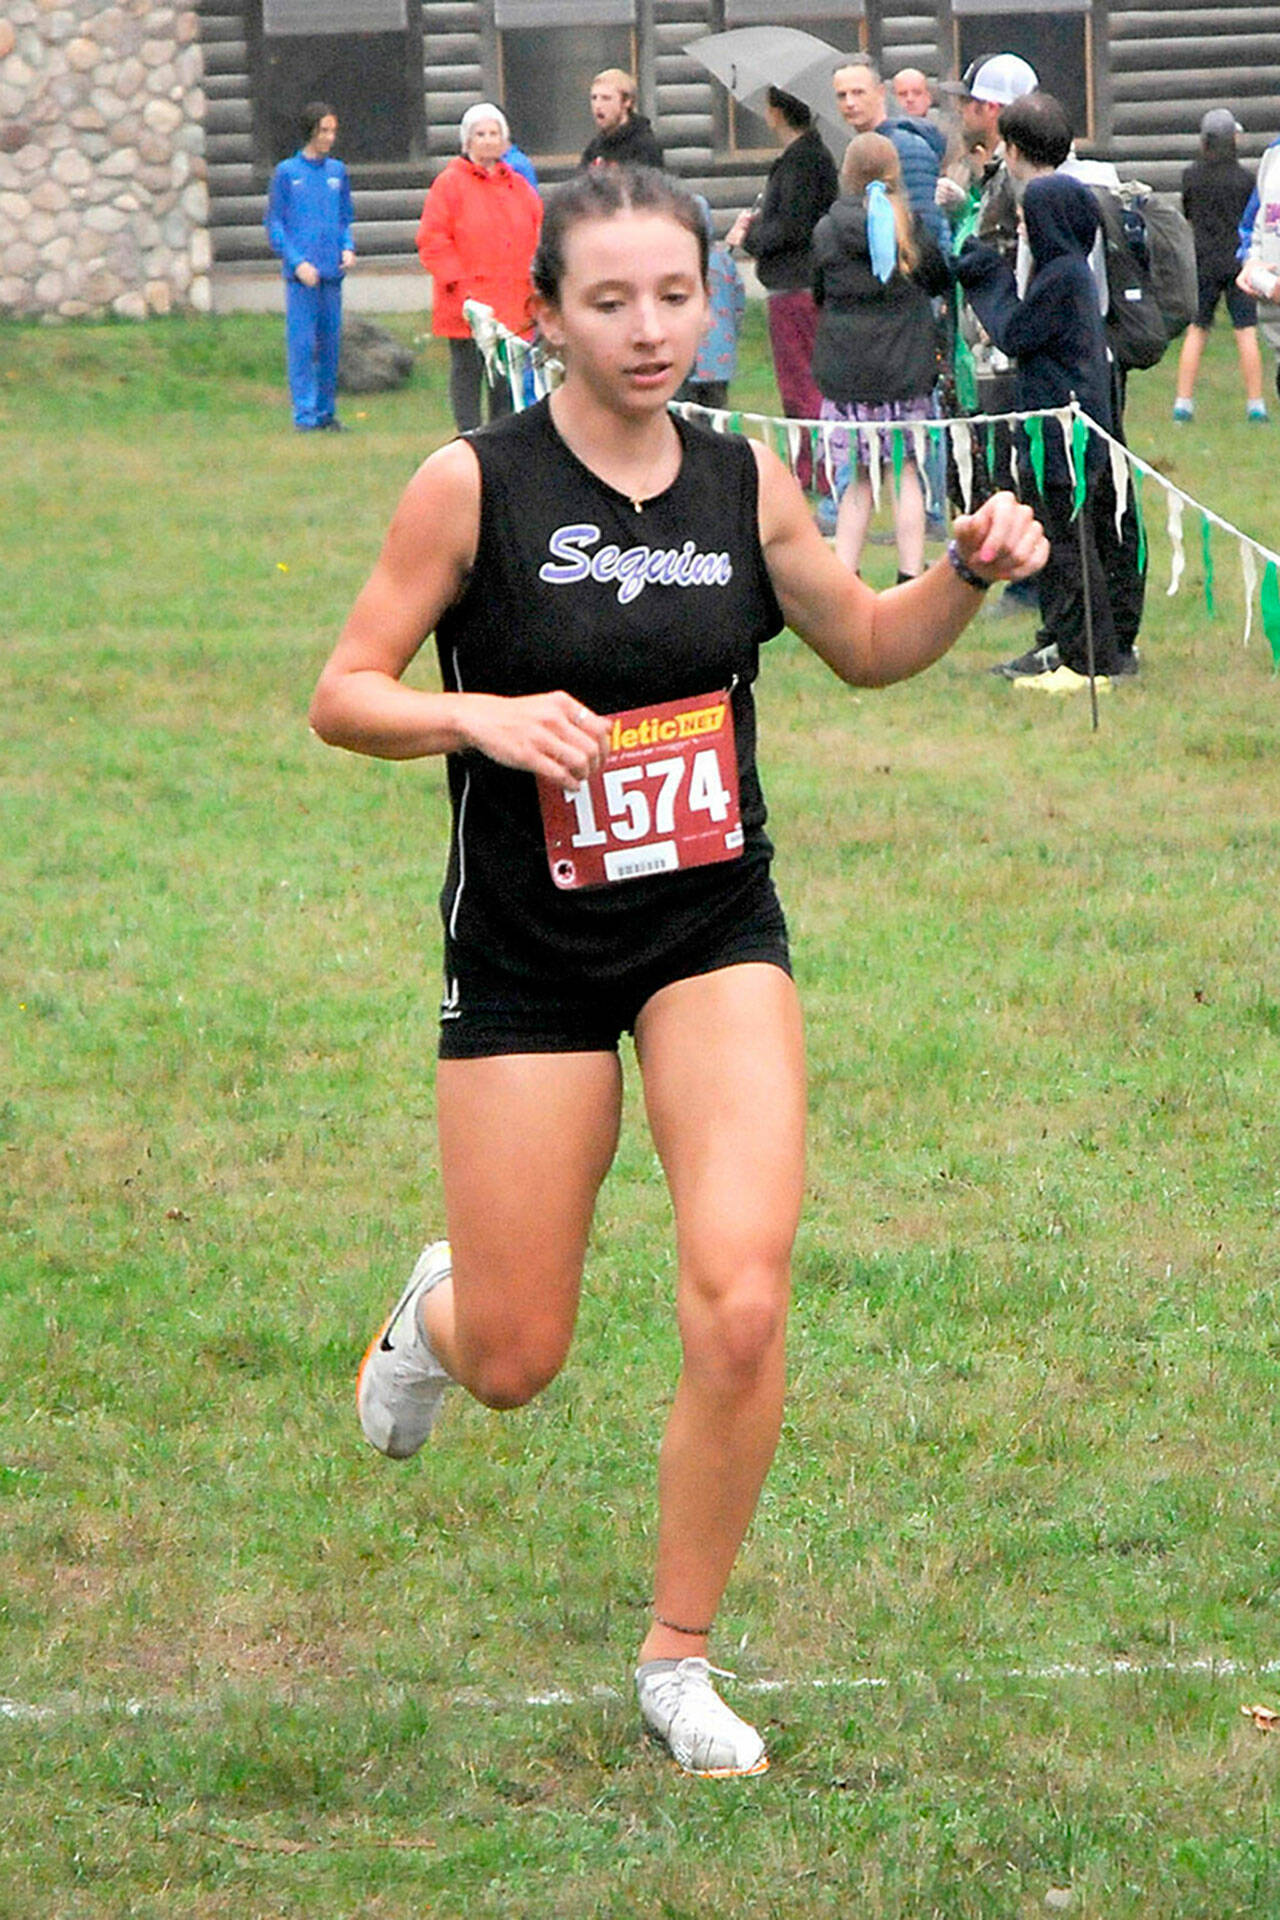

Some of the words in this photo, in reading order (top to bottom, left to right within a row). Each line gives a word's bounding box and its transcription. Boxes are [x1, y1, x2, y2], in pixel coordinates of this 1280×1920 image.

[539, 523, 733, 604] Sequim
[607, 717, 678, 751] letic
[563, 749, 731, 847] 1574
